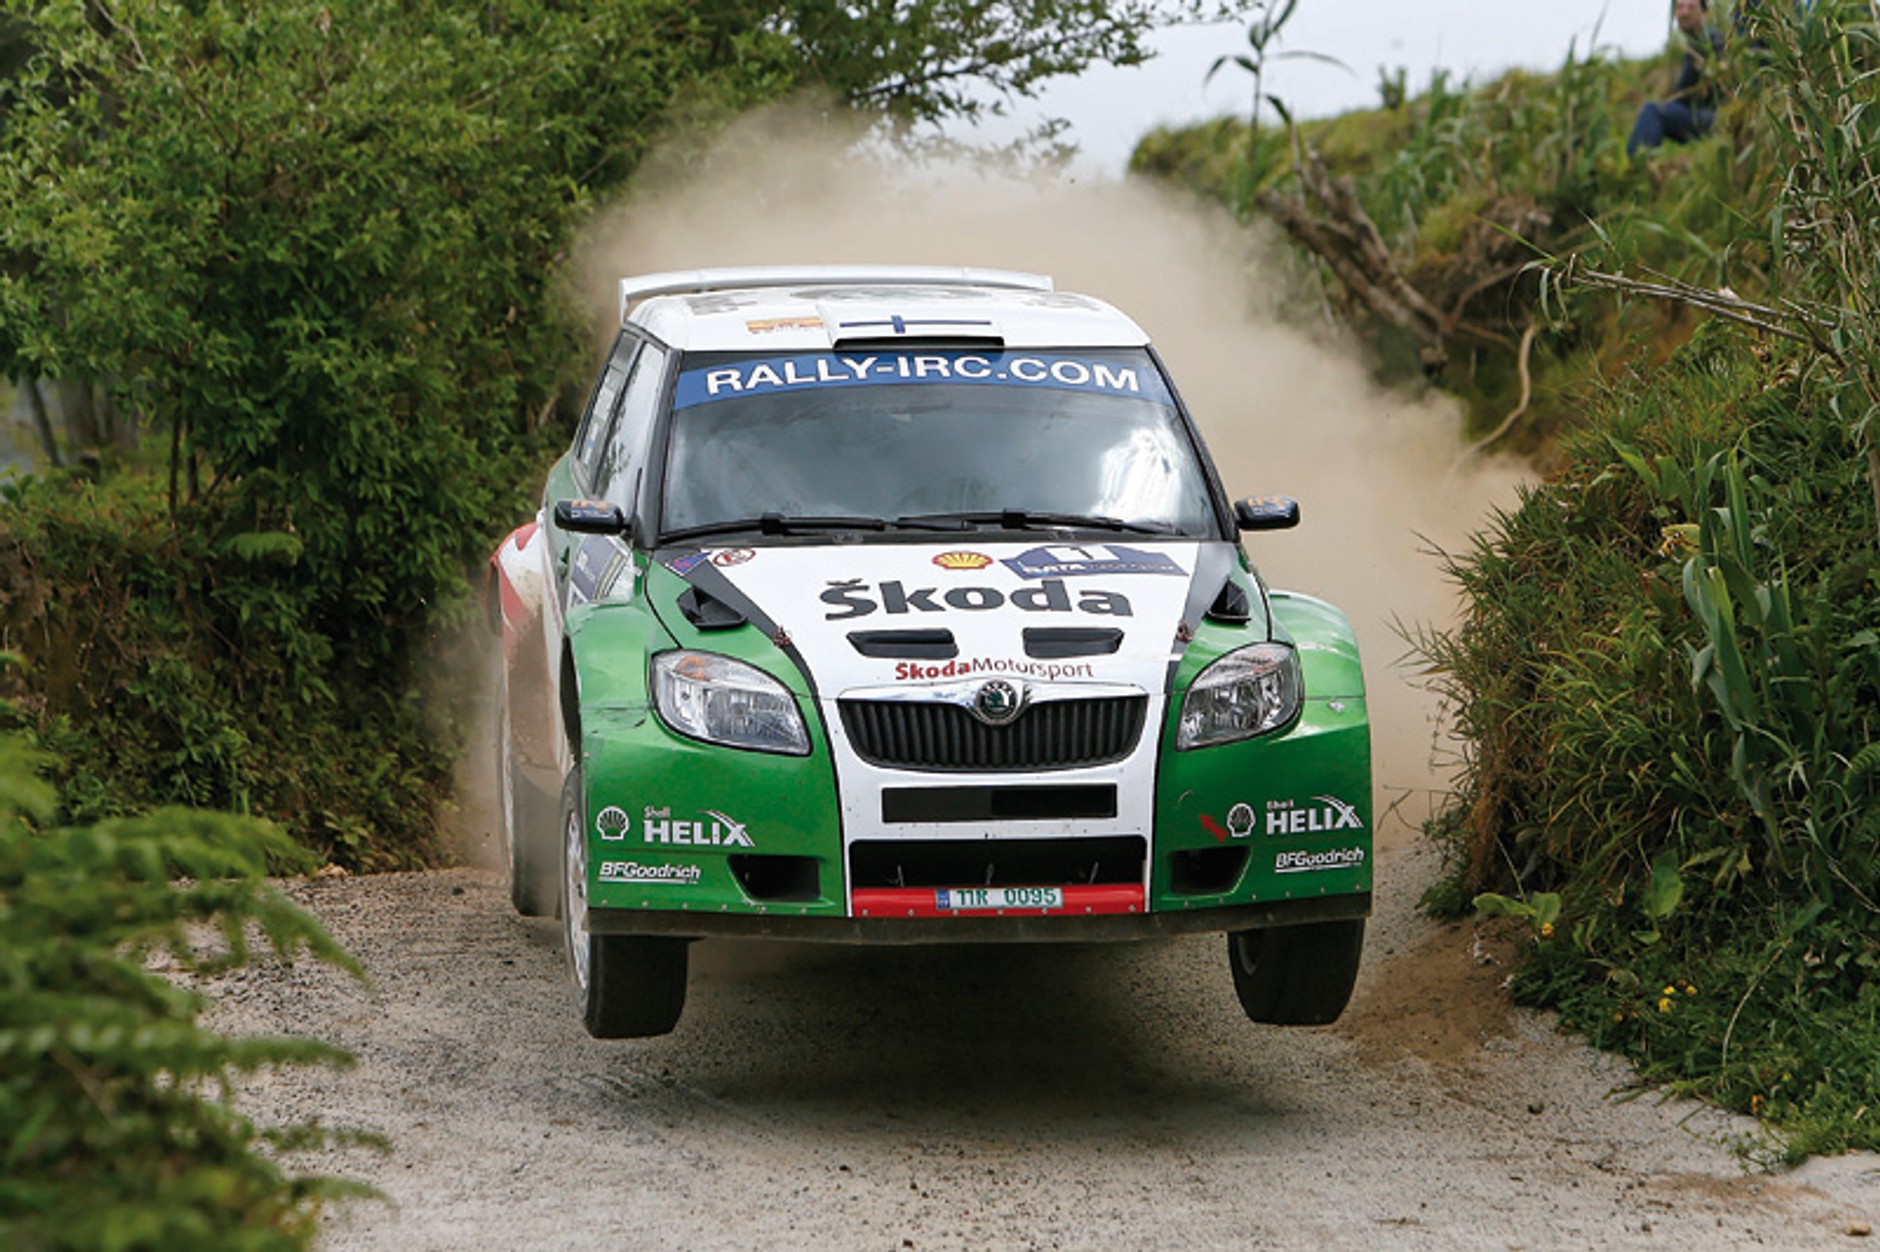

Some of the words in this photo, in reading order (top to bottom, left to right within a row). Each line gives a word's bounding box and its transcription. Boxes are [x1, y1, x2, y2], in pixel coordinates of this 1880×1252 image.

[705, 355, 1139, 395] RALLY-IRC.COM
[818, 577, 1134, 621] Škoda
[643, 810, 755, 847] HELIX
[1266, 795, 1364, 835] HELIX
[599, 862, 701, 879] BFGoodrich
[1275, 847, 1365, 869] BFGoodrich
[1003, 887, 1057, 905] 0095
